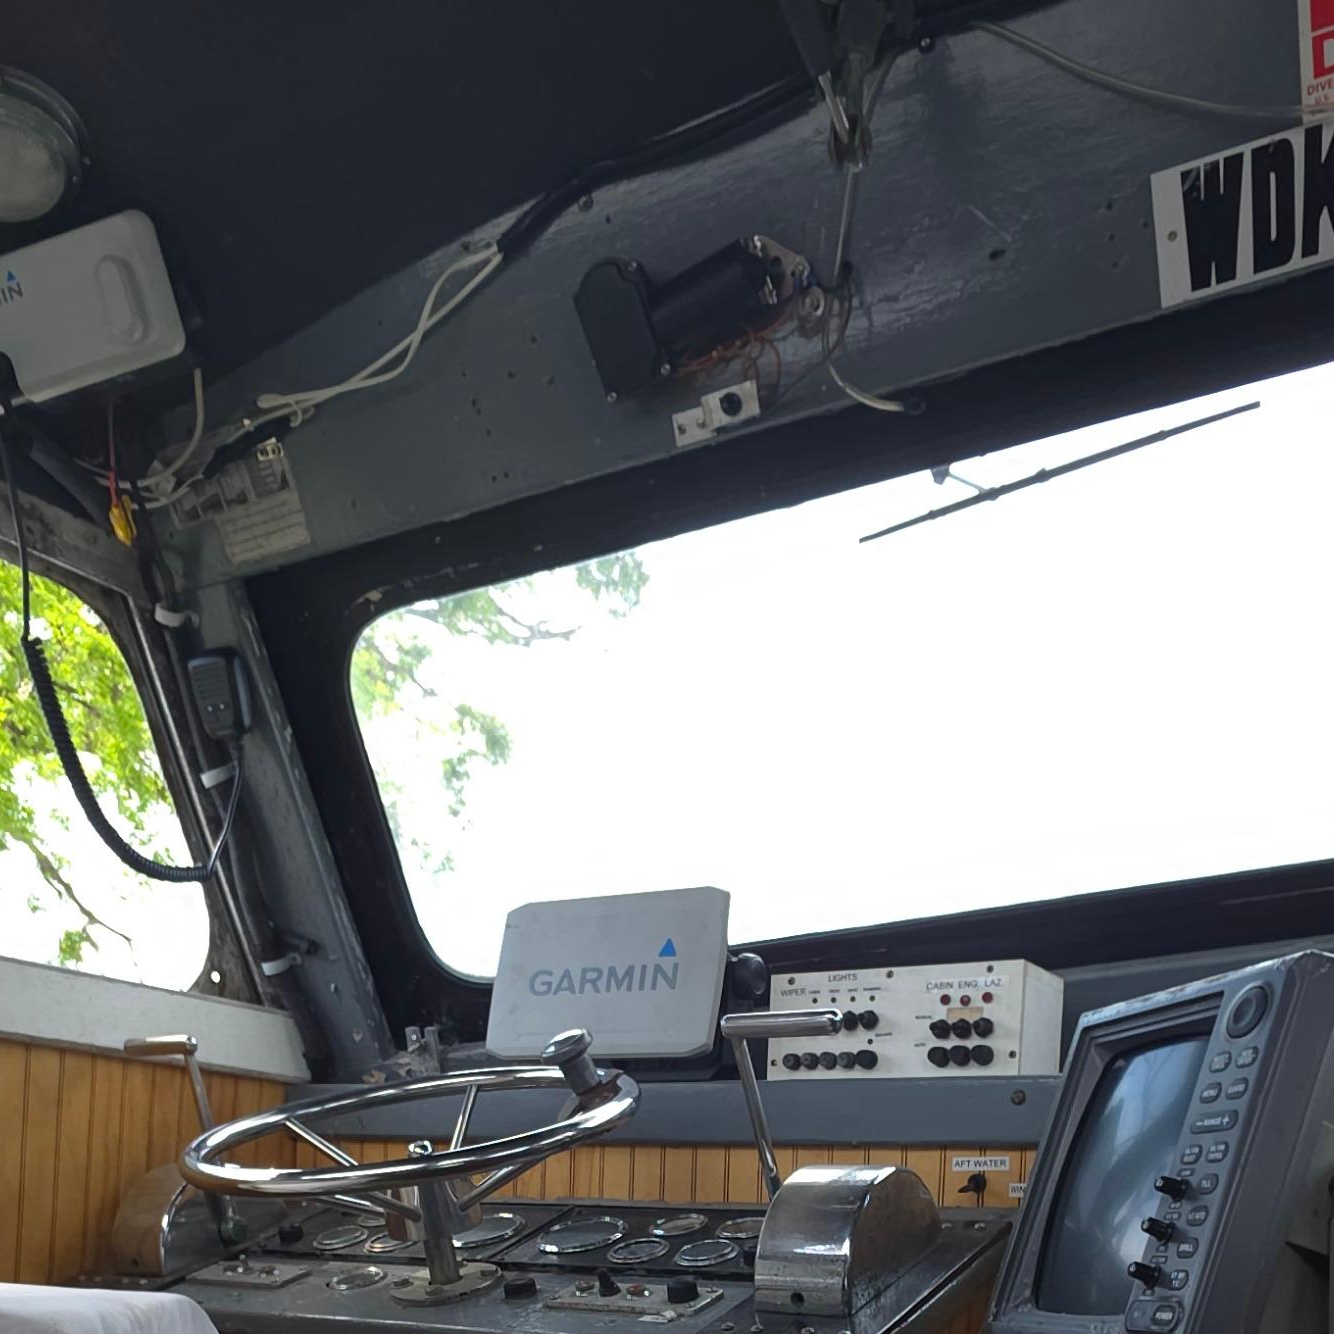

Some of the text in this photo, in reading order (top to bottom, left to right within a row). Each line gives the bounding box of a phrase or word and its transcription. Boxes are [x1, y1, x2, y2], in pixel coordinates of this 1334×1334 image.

[529, 962, 679, 997] GARMIN
[828, 973, 858, 983] LIGHTS
[926, 978, 1002, 991] CABIN ENG LAZ
[780, 988, 806, 997] WIPER
[954, 1159, 1007, 1168] AFT WATER
